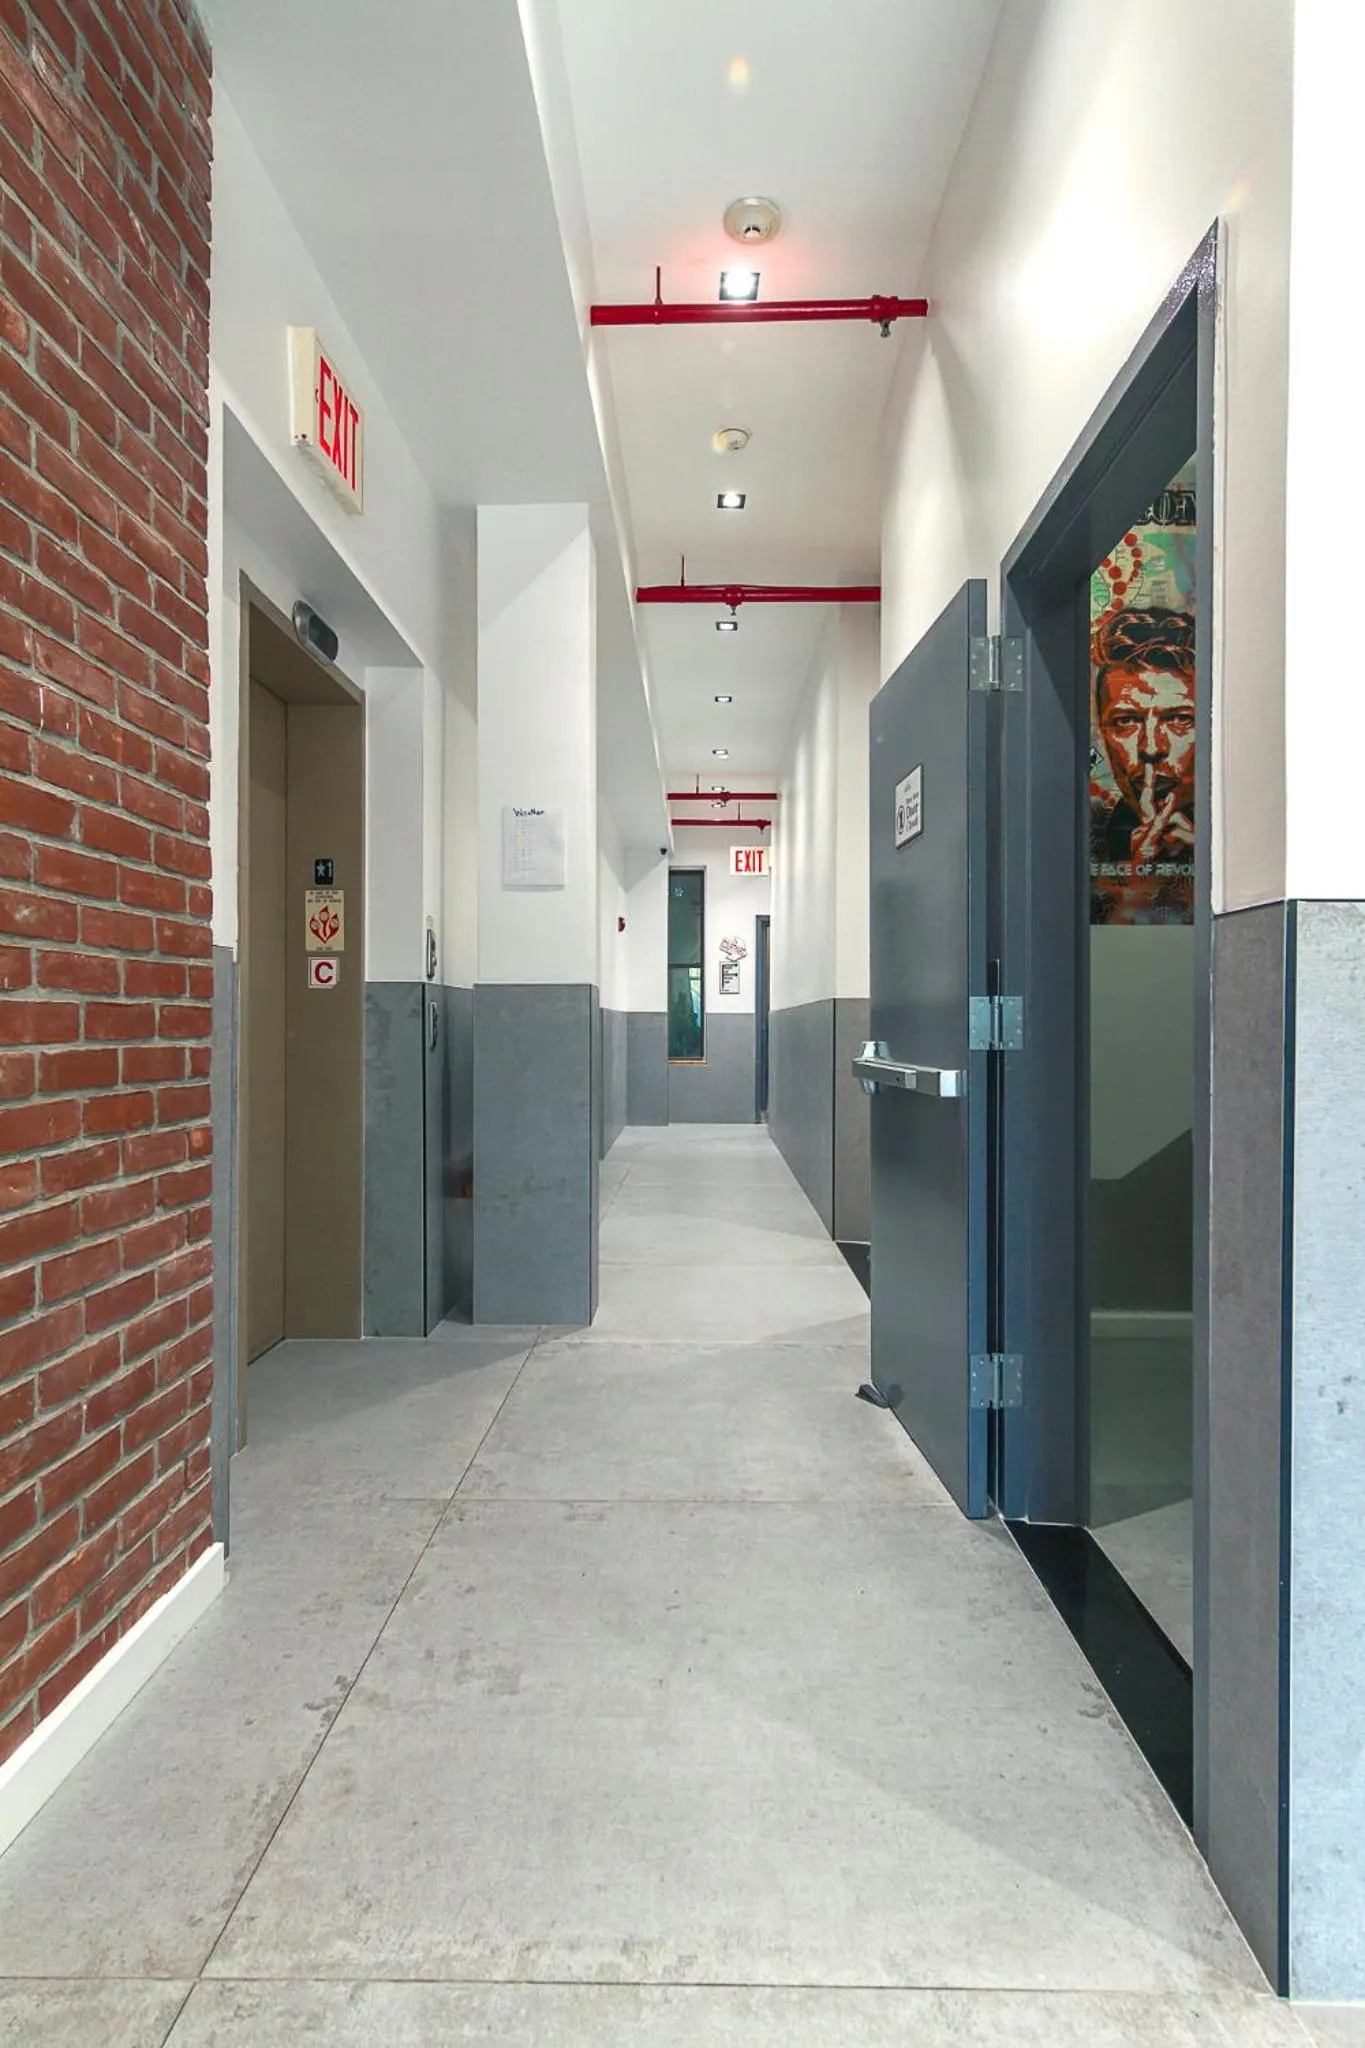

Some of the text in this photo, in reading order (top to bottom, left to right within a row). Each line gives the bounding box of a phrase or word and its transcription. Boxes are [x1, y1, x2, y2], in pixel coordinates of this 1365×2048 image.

[319, 356, 359, 491] EXIT
[735, 850, 764, 872] EXIT
[1101, 863, 1132, 876] FACE
[1136, 863, 1153, 876] OF
[314, 961, 334, 984] C
